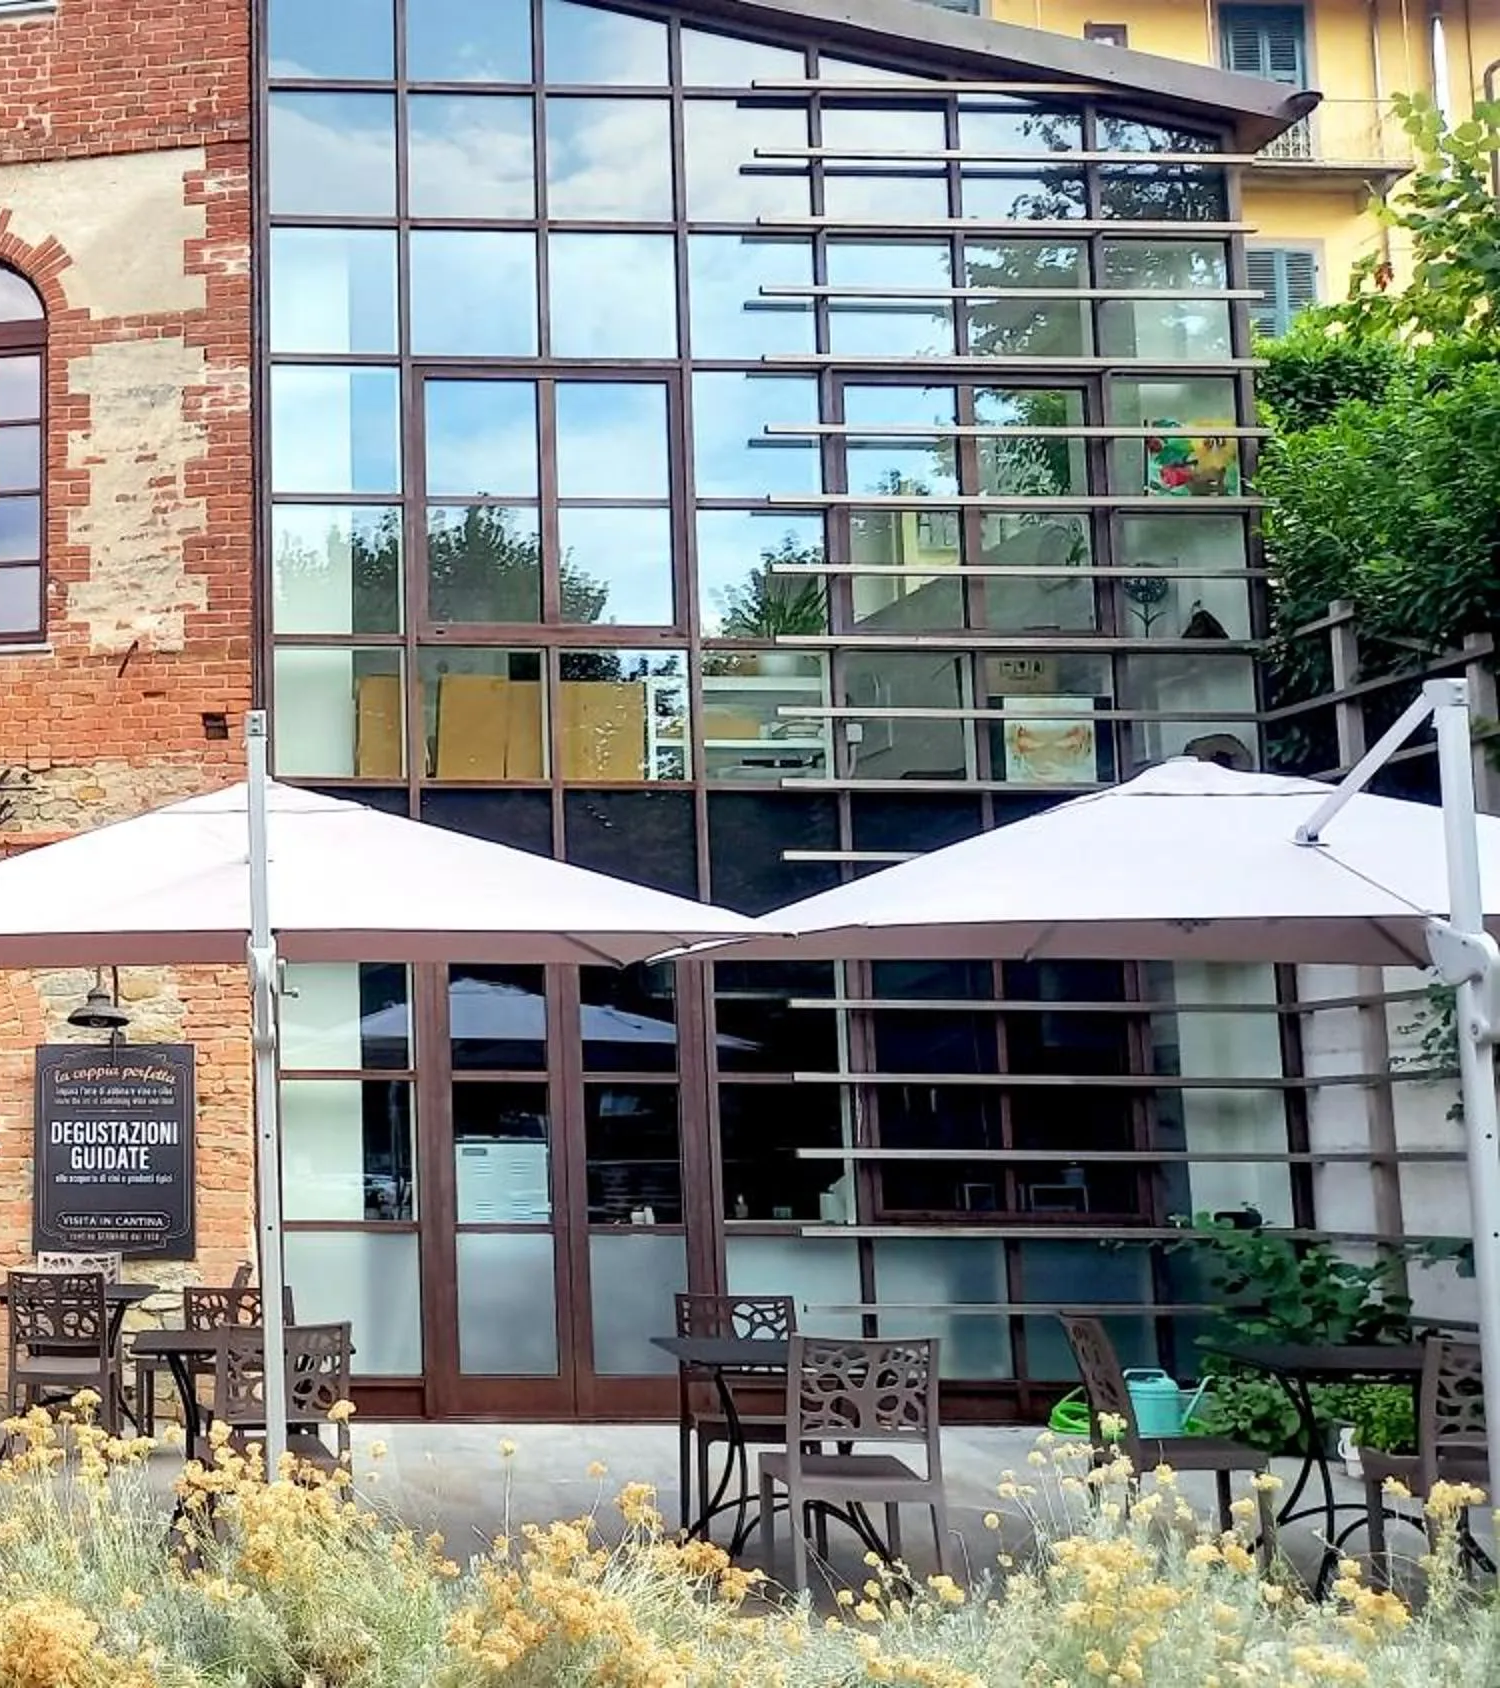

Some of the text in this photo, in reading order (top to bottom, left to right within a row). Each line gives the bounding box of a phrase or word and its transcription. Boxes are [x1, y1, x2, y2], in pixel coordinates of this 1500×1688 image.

[54, 1063, 177, 1085] la coppia perfetta
[51, 1121, 178, 1145] DEGUSTAZIONI
[71, 1146, 150, 1170] GUIDATE
[62, 1215, 164, 1227] VISITA IN CANTINA
